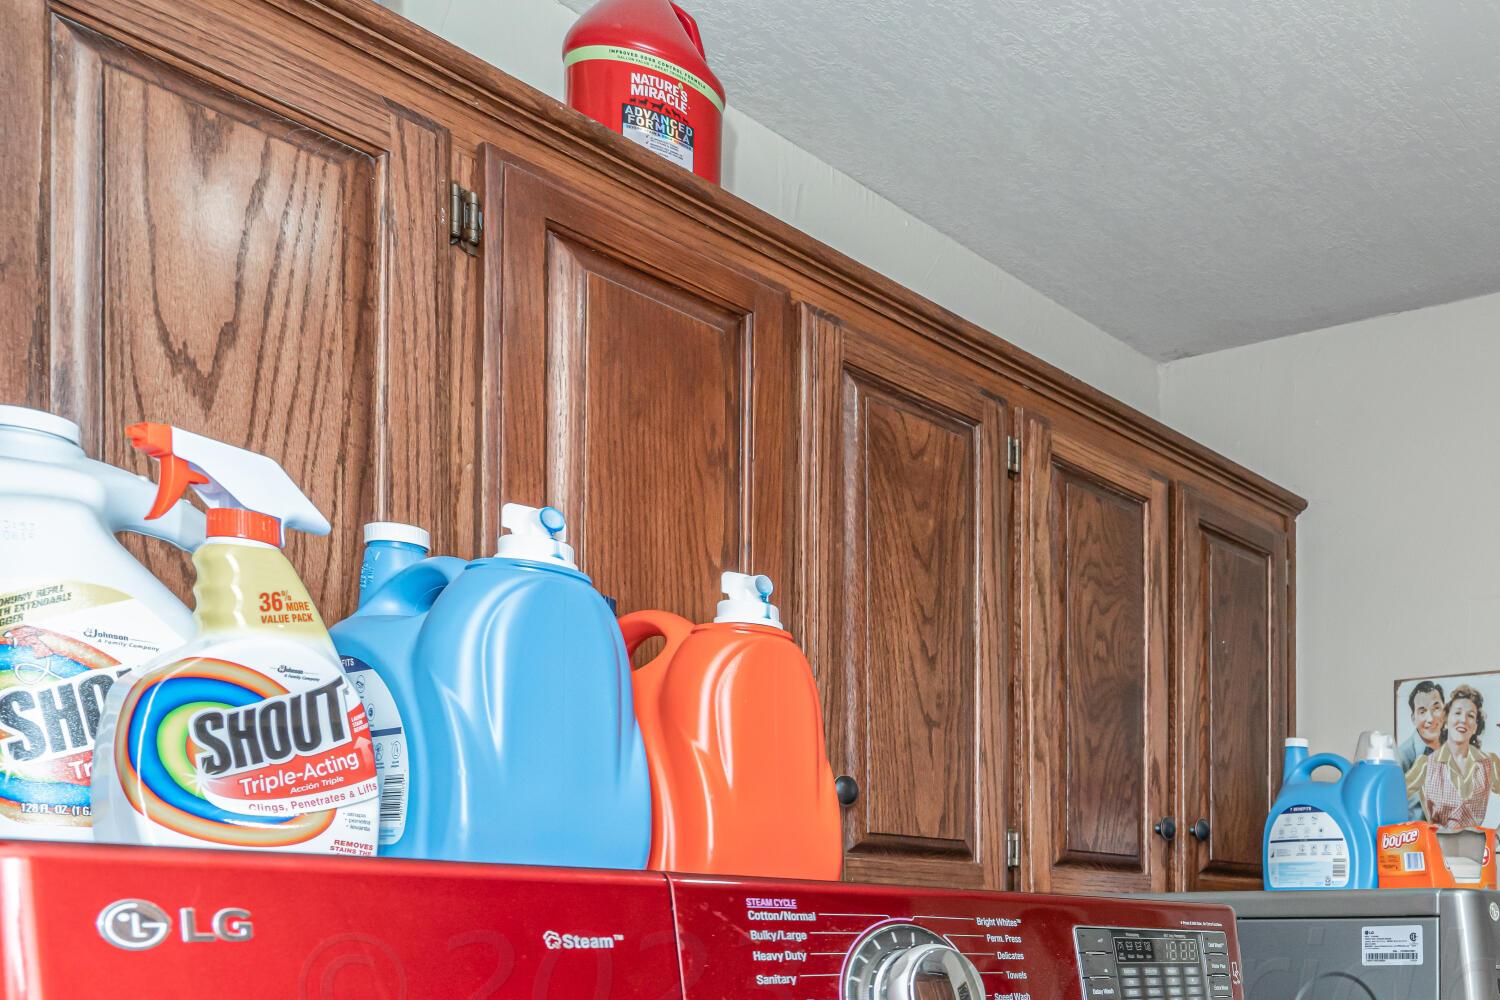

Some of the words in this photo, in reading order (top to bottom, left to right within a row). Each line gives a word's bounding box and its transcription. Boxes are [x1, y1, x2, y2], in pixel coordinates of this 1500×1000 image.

[631, 72, 688, 103] NATURE'S
[631, 84, 688, 115] MIRACLE
[625, 105, 693, 137] ADVANCED
[628, 115, 690, 145] FORMULA
[286, 601, 310, 612] MORE
[261, 614, 290, 624] VALUE
[292, 613, 314, 623] PACK
[0, 668, 132, 762] SHO
[193, 675, 346, 776] SHOUT
[239, 752, 360, 796] Triple-Acting
[290, 782, 320, 795] Acción
[321, 775, 345, 787] Triple
[248, 803, 288, 814] Clings,
[291, 792, 346, 811] Penetrates
[349, 789, 356, 798] &
[357, 782, 378, 797] Lifts
[20, 803, 39, 814] 128
[82, 806, 92, 816] G
[334, 839, 374, 851] REMOVES
[1381, 828, 1419, 850] bounce
[330, 846, 357, 855] STAINS
[746, 897, 773, 907] STEAM
[773, 898, 798, 907] CYCLE
[747, 909, 817, 921] Cotton/Normal
[180, 906, 254, 943] LG
[976, 917, 996, 928] Bright
[749, 929, 808, 942] Bulky/Large
[986, 933, 1005, 943] Perm.
[1005, 934, 1022, 944] Press
[752, 950, 783, 963] Heavy
[784, 950, 807, 962] Duty
[996, 951, 1025, 960] Delicates
[755, 974, 797, 986] Sanitary
[1005, 970, 1028, 980] Towels
[1013, 992, 1031, 1000] Wash
